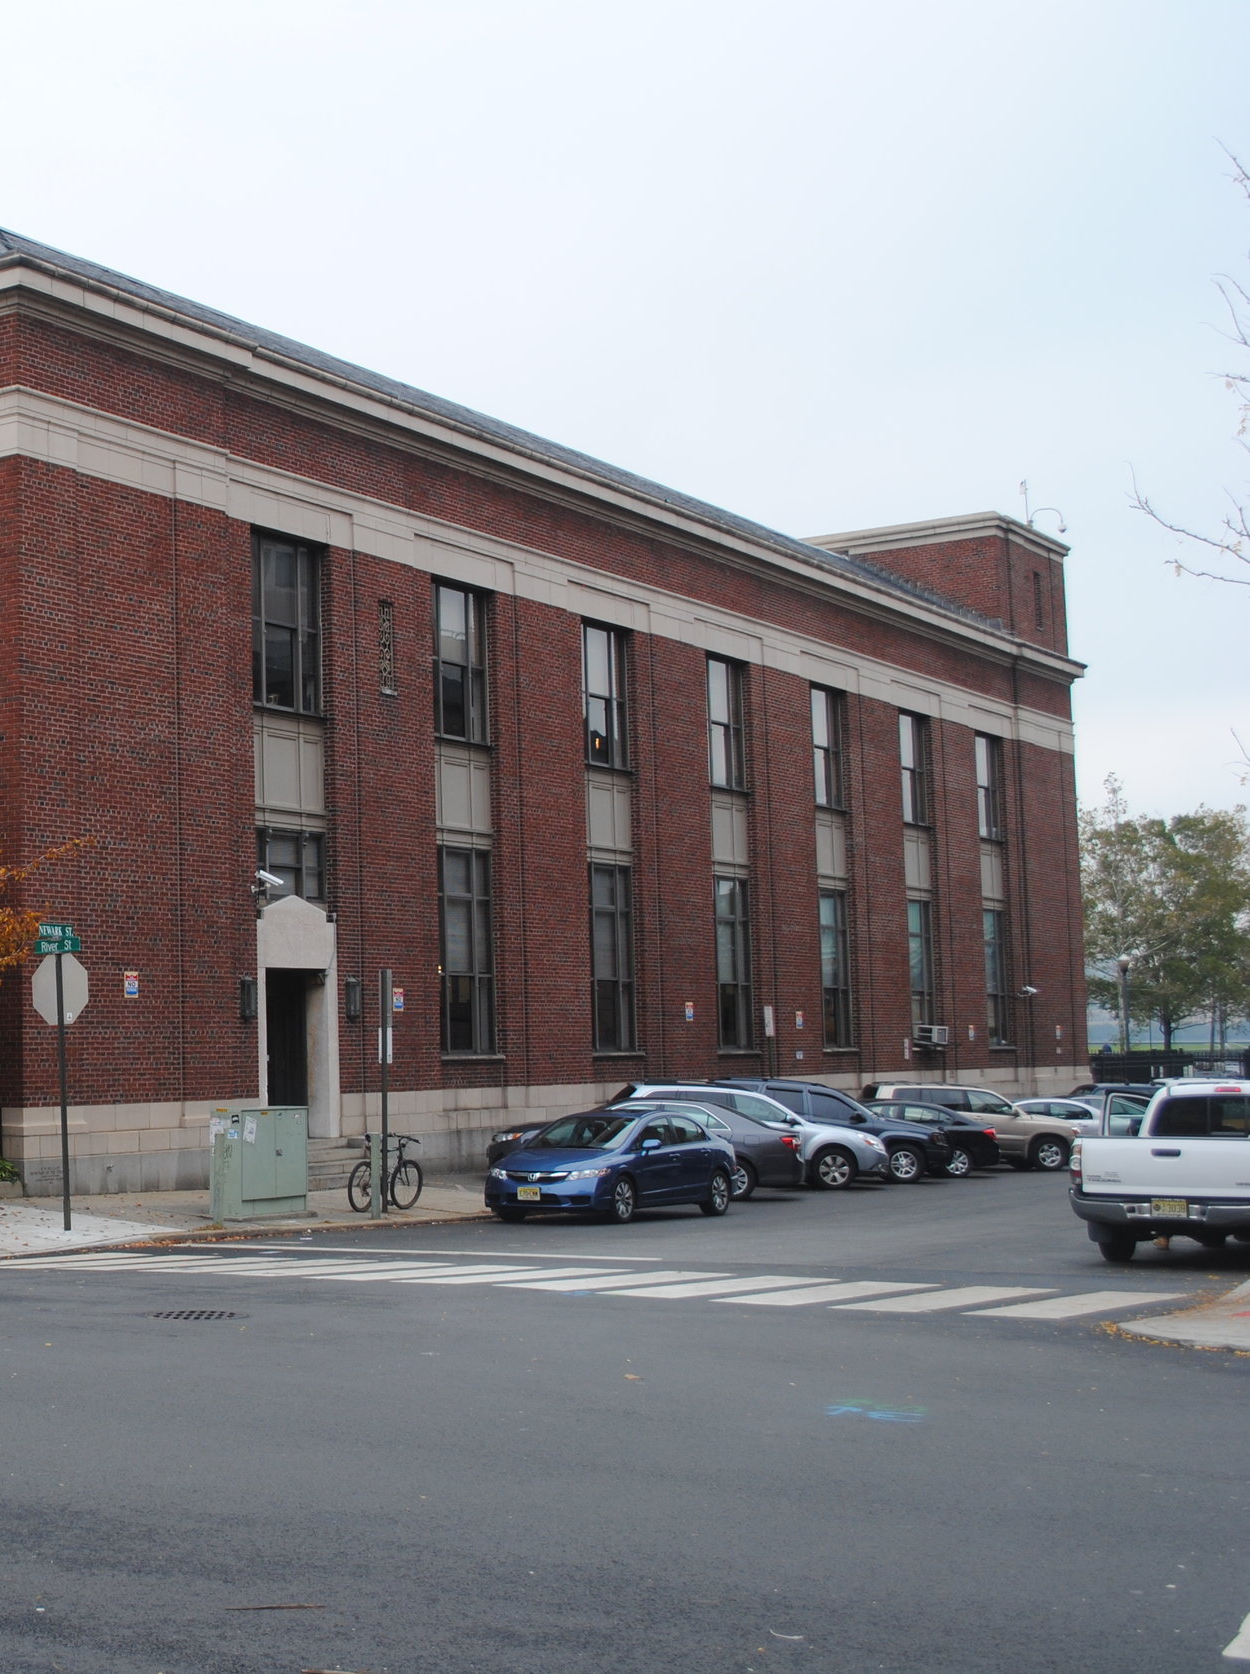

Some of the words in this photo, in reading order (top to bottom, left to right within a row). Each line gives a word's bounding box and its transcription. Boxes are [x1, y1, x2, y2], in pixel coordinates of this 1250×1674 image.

[39, 925, 63, 937] NEWARK
[41, 941, 59, 953] River
[64, 939, 73, 951] St
